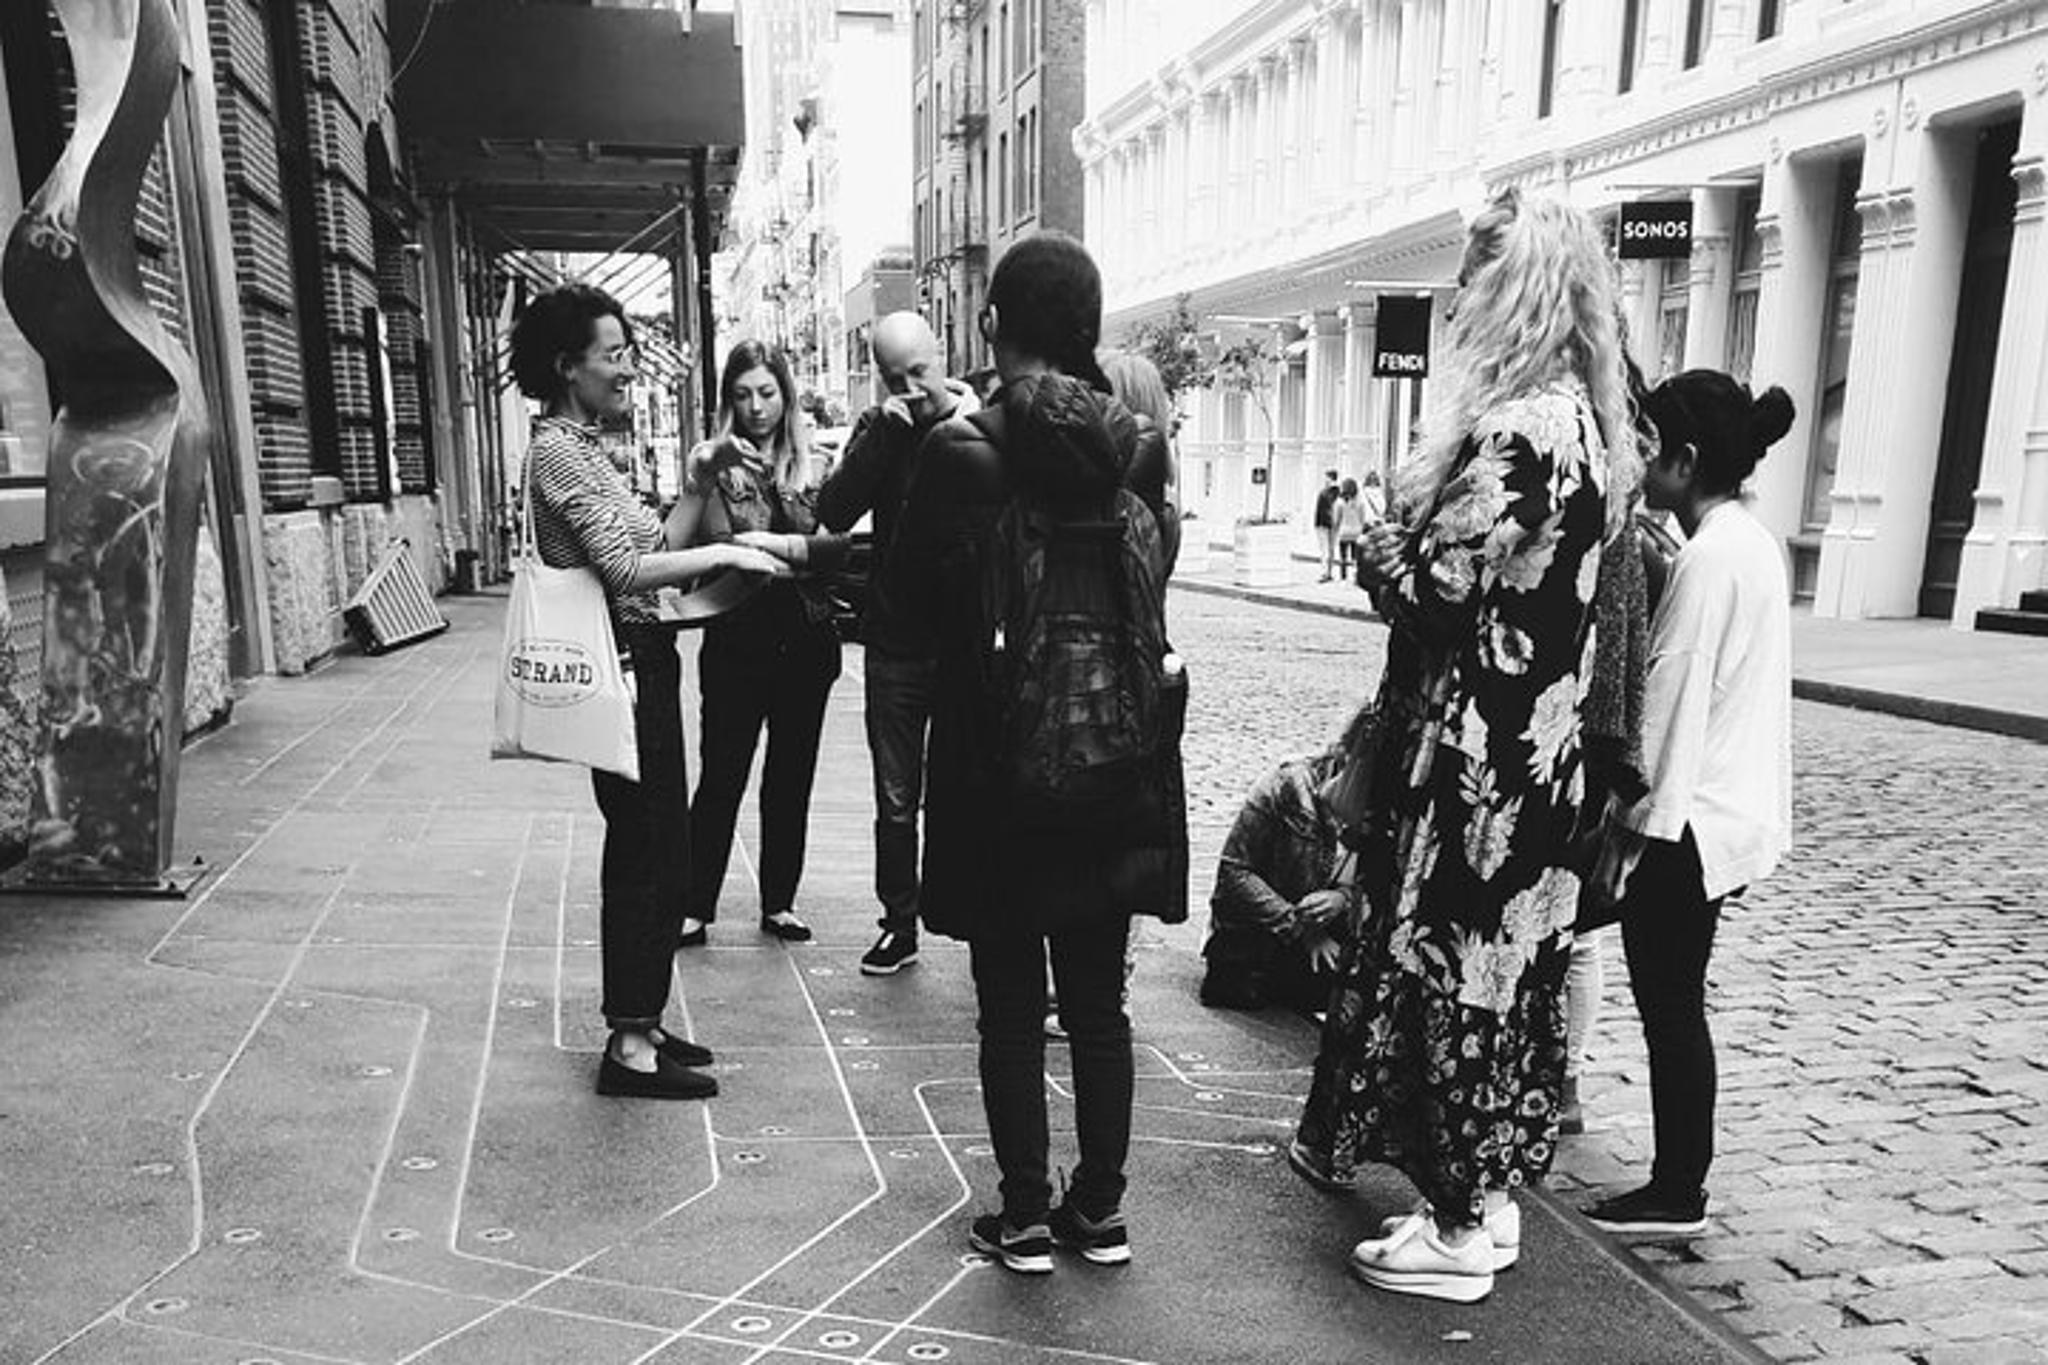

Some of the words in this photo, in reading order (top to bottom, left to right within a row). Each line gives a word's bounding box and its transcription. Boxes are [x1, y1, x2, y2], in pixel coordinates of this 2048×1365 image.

[1624, 221, 1688, 239] SONOS
[1379, 352, 1423, 371] FENDI
[511, 656, 592, 686] STRAND
